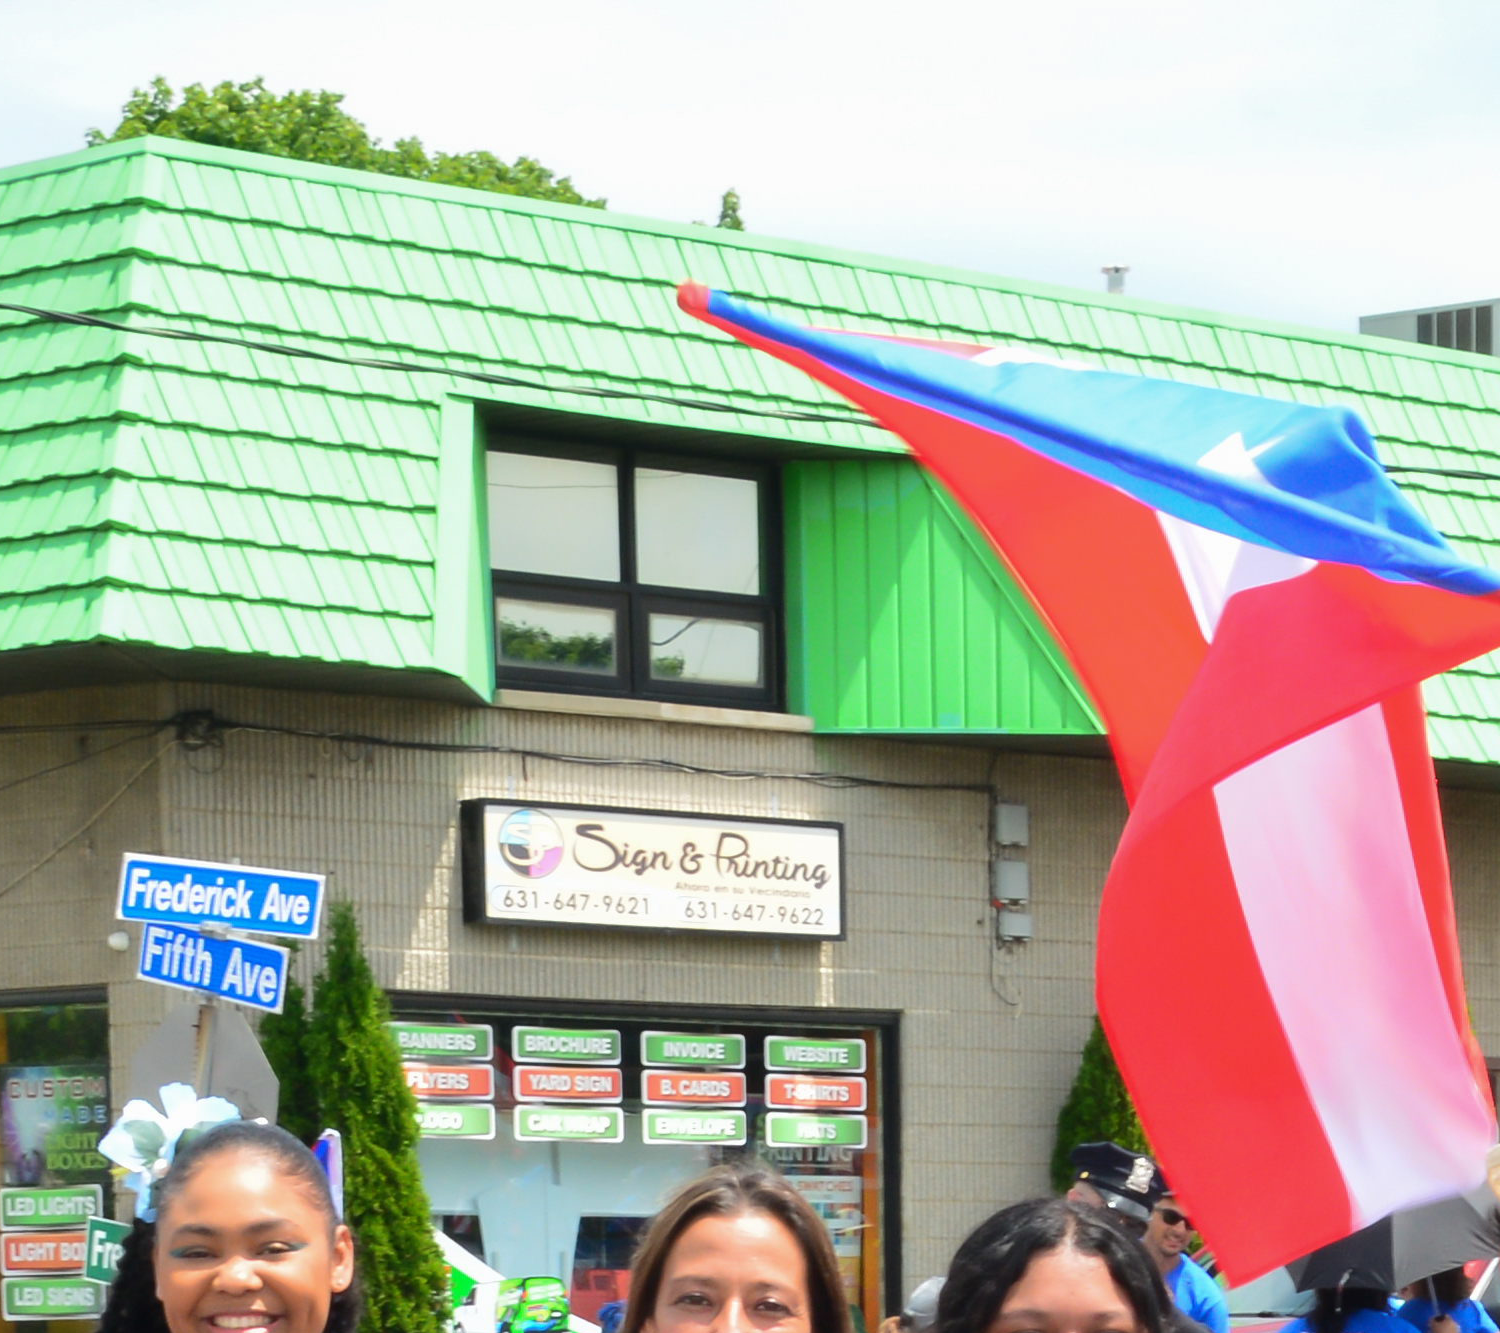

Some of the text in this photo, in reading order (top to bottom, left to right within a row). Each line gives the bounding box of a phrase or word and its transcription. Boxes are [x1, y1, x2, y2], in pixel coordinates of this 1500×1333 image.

[573, 824, 832, 890] Sign & Printing
[127, 868, 310, 925] Frederick Ave
[503, 889, 825, 926] 631-647-9621 631-647-9622
[143, 927, 278, 1003] Fifth Ave
[399, 1032, 476, 1051] BANNERS
[525, 1034, 613, 1055] BROCHURE
[663, 1041, 725, 1059] INVOICE
[783, 1045, 849, 1065] WEBSITE
[8, 1077, 107, 1099] CUSTOM
[407, 1071, 470, 1090] FLYERS
[528, 1073, 613, 1093] YARD SIGN
[661, 1079, 731, 1097] B. CARDS
[784, 1083, 849, 1102] T-SHIRTS
[528, 1114, 612, 1134] CAR WRAP
[655, 1116, 736, 1136] ENVELOPE
[47, 1152, 109, 1170] BOXES
[6, 1196, 96, 1216] LED LIGHTS
[10, 1242, 55, 1261] LIGHT
[14, 1287, 95, 1306] LED SIGNS
